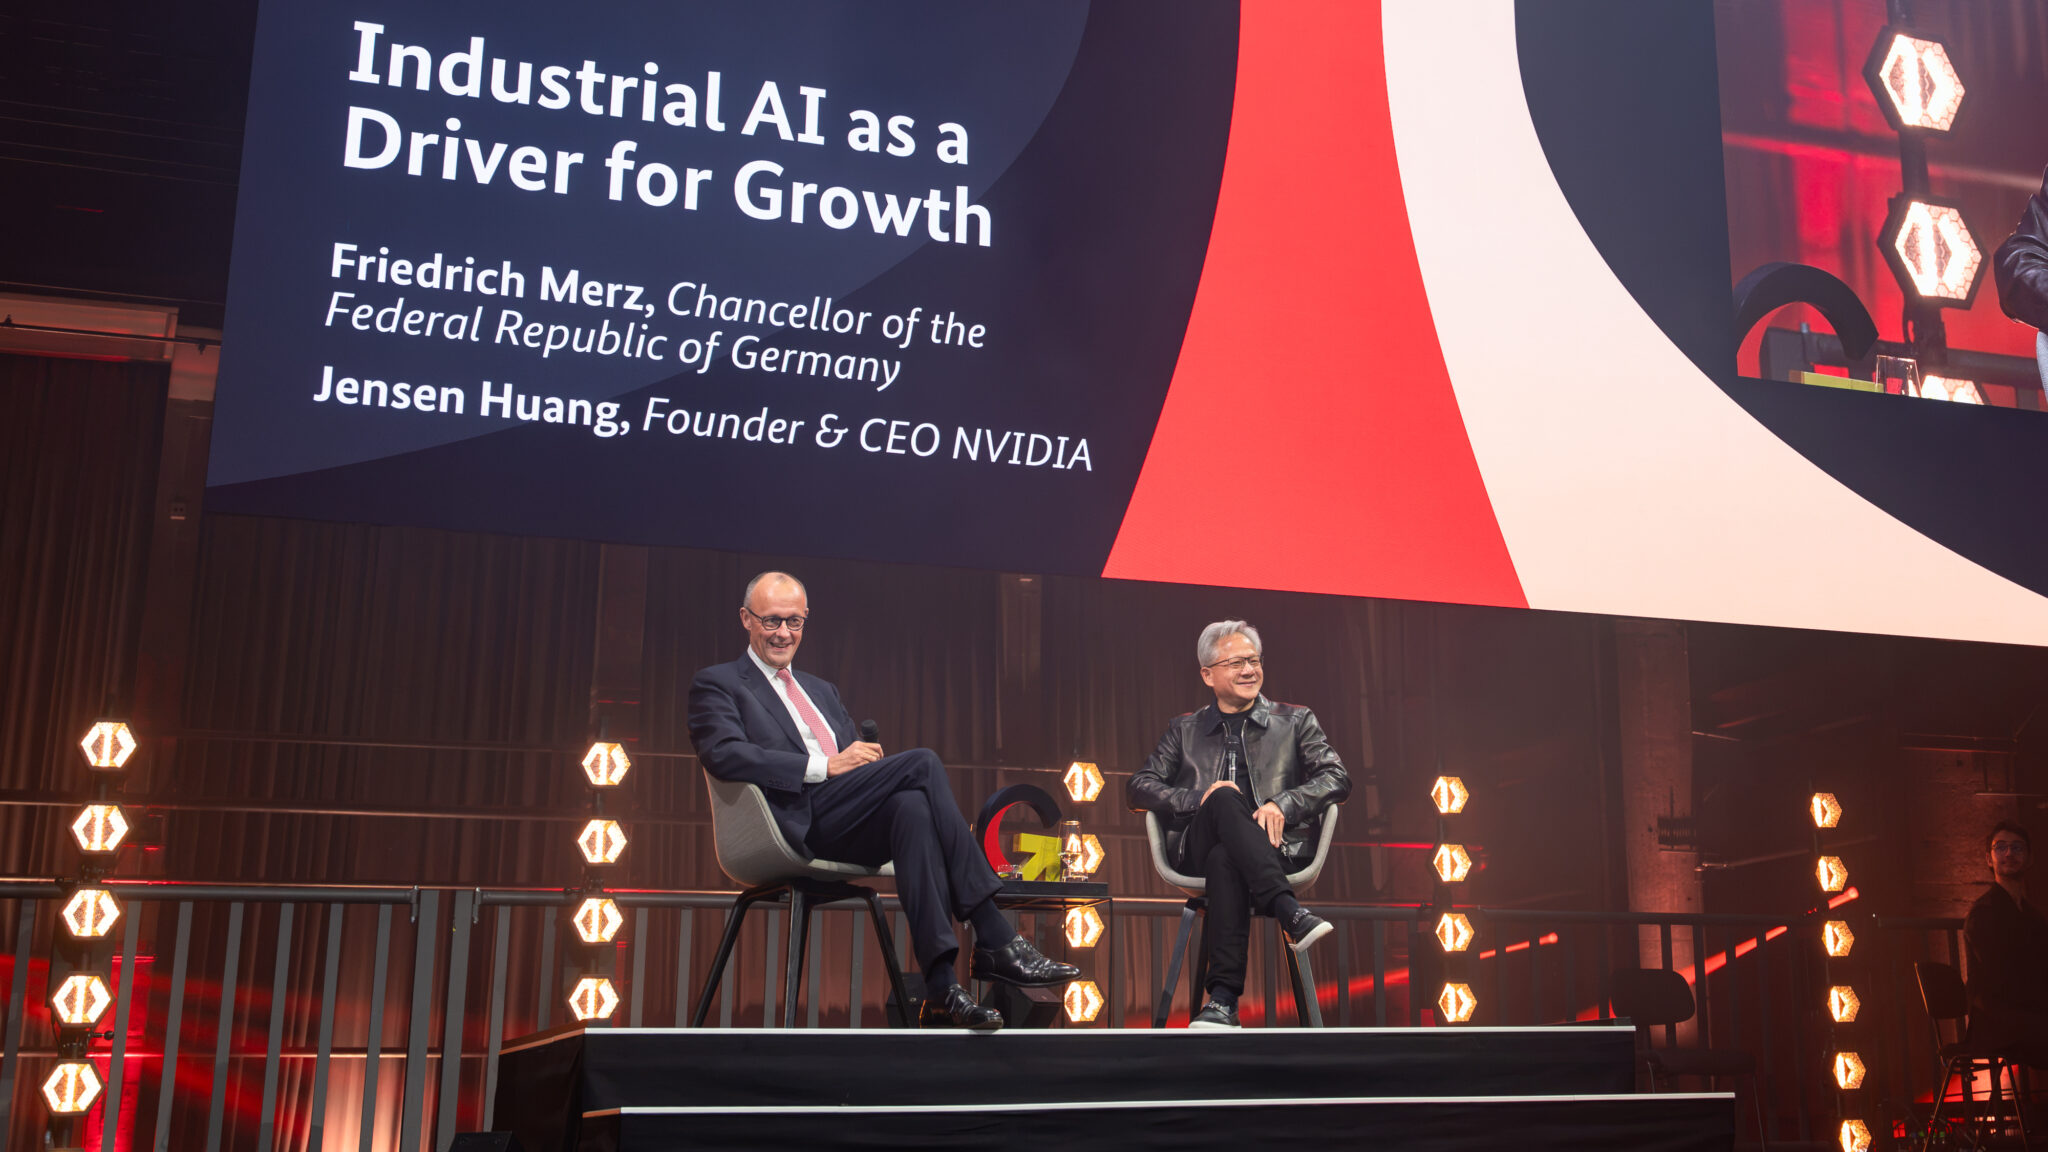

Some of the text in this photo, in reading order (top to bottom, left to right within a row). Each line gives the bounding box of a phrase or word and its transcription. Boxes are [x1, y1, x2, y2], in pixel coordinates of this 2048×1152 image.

[348, 20, 969, 166] Industrial AI as a
[343, 105, 992, 247] Driver for Growth
[324, 291, 901, 392] Federal Republic of Germany
[331, 242, 986, 349] Friedrich Merz, Chancellor of the
[313, 365, 1092, 472] Jensen Huang, Founder & CEO NVIDIA
